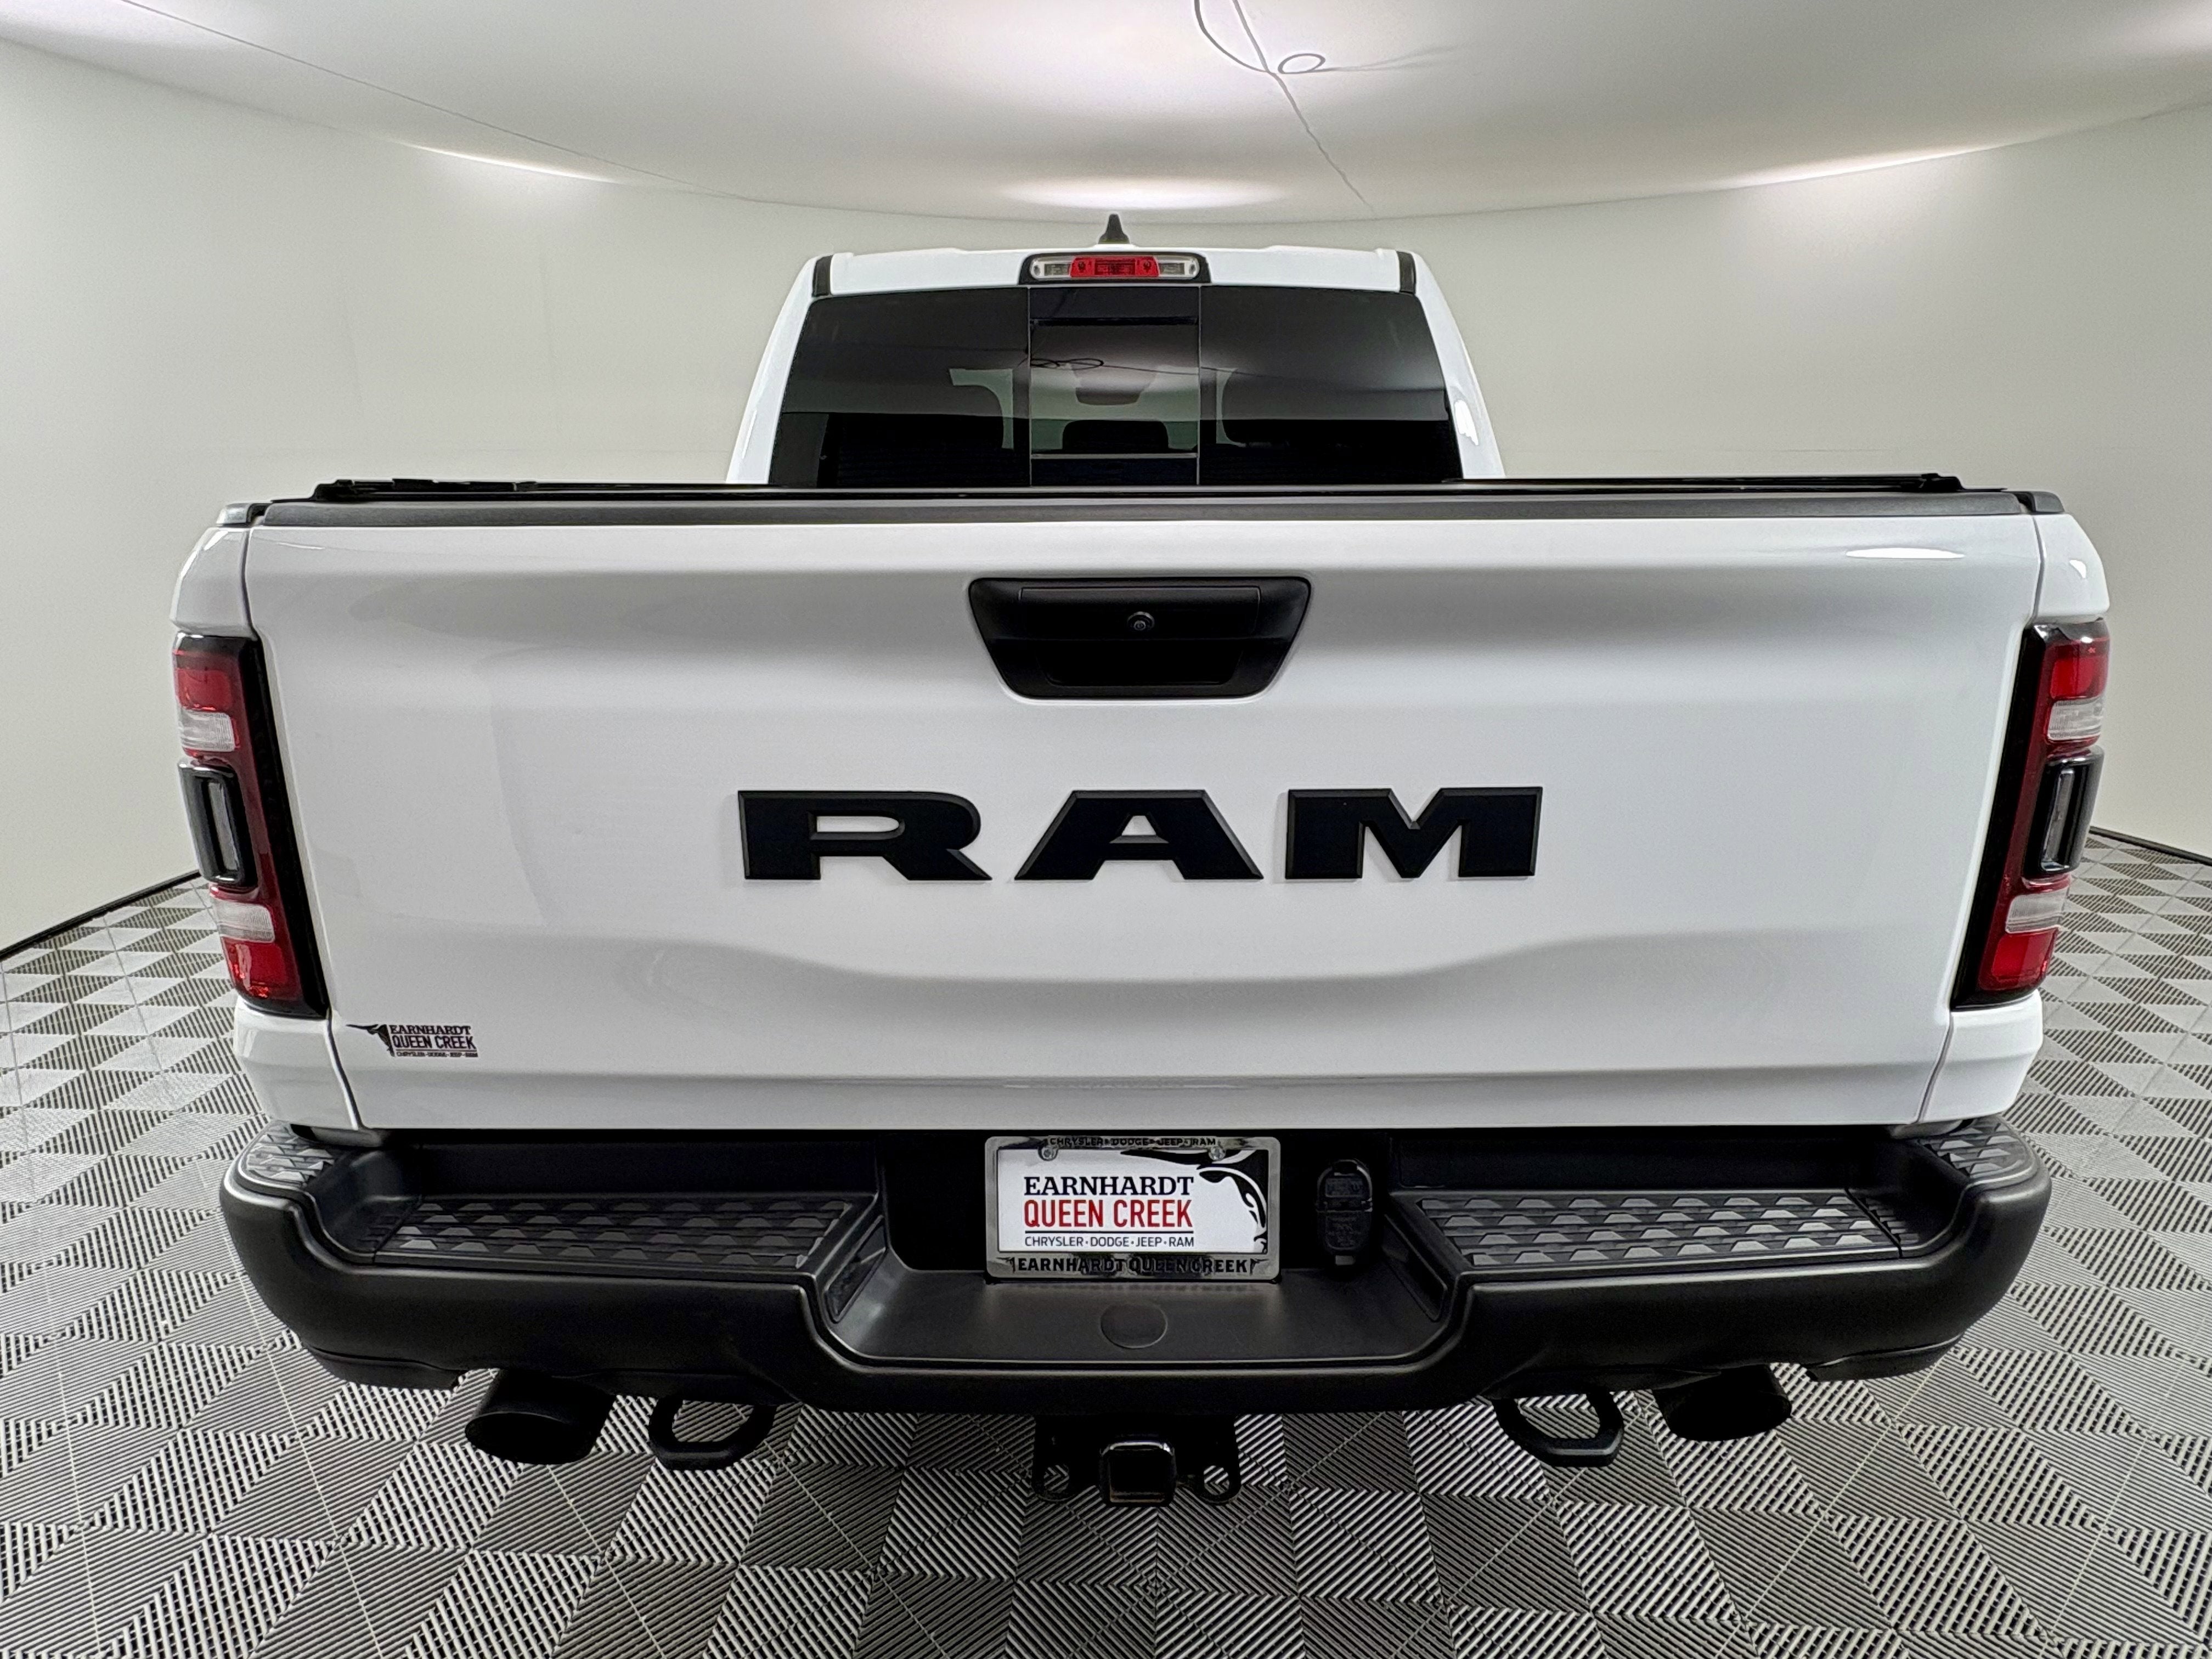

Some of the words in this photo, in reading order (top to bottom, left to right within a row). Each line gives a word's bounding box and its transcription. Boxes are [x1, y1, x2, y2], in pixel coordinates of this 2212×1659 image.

[738, 787, 1543, 881] RAM
[390, 1025, 471, 1034] EARNHARDT
[392, 1036, 432, 1048] QUEEN
[435, 1036, 476, 1049] CREEK
[1024, 1177, 1194, 1195] EARNHARDT
[1024, 1200, 1104, 1227] QUEEN
[1113, 1200, 1192, 1227] CREEK
[1018, 1258, 1125, 1272] EARNHARDT
[1128, 1258, 1188, 1273] QUEEN
[1191, 1259, 1247, 1273] CREEK
